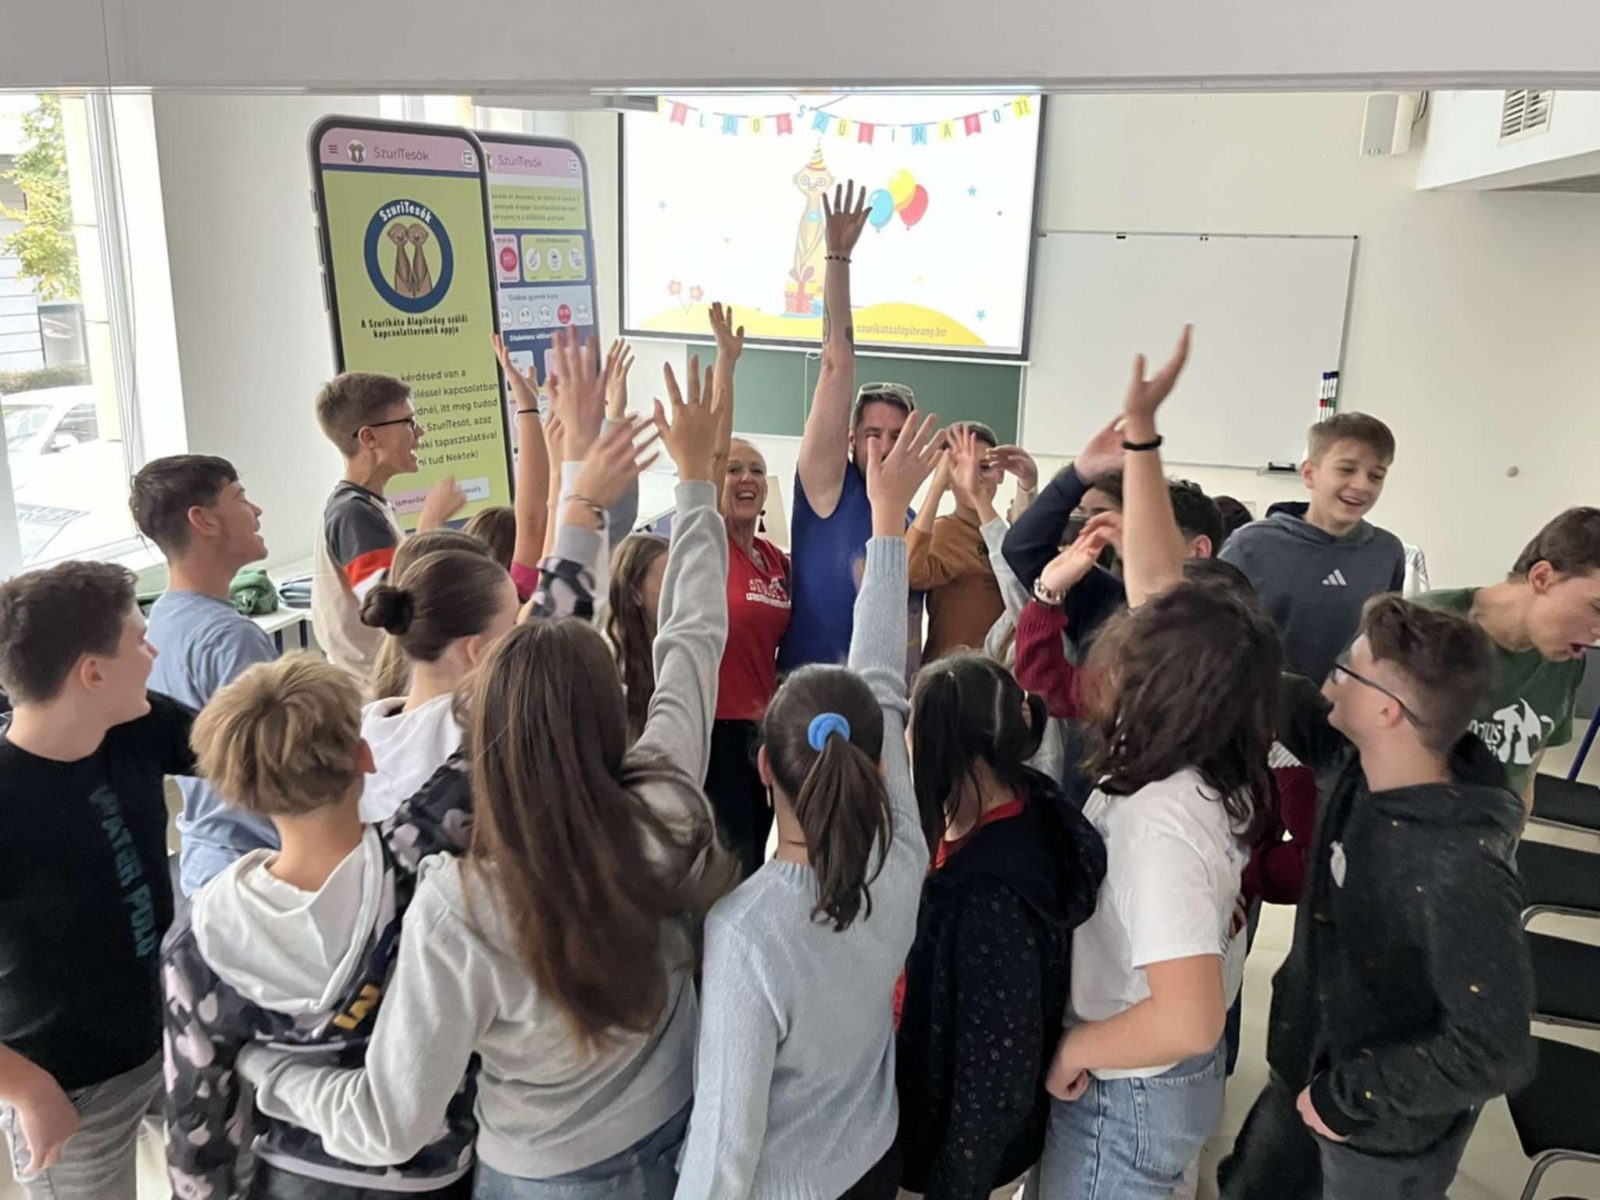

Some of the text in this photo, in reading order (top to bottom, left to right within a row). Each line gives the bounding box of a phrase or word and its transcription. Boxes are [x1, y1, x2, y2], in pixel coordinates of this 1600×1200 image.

[373, 146, 430, 162] SzuriTesók
[379, 201, 433, 224] SzuriTesók
[360, 319, 366, 329] A
[368, 317, 405, 329] Szurikáta
[407, 315, 446, 327] Alapítvány
[373, 324, 459, 339] kapcsolatteremtő appja
[443, 370, 460, 379] van
[443, 382, 498, 396] kapcsolatban
[415, 406, 440, 417] dnél,
[441, 404, 450, 414] itt
[453, 402, 472, 413] meg
[473, 398, 498, 410] tudod
[474, 416, 491, 425] azaz
[435, 430, 498, 448] tapasztalatával
[428, 453, 444, 466] tud
[446, 450, 479, 463] Nektek!
